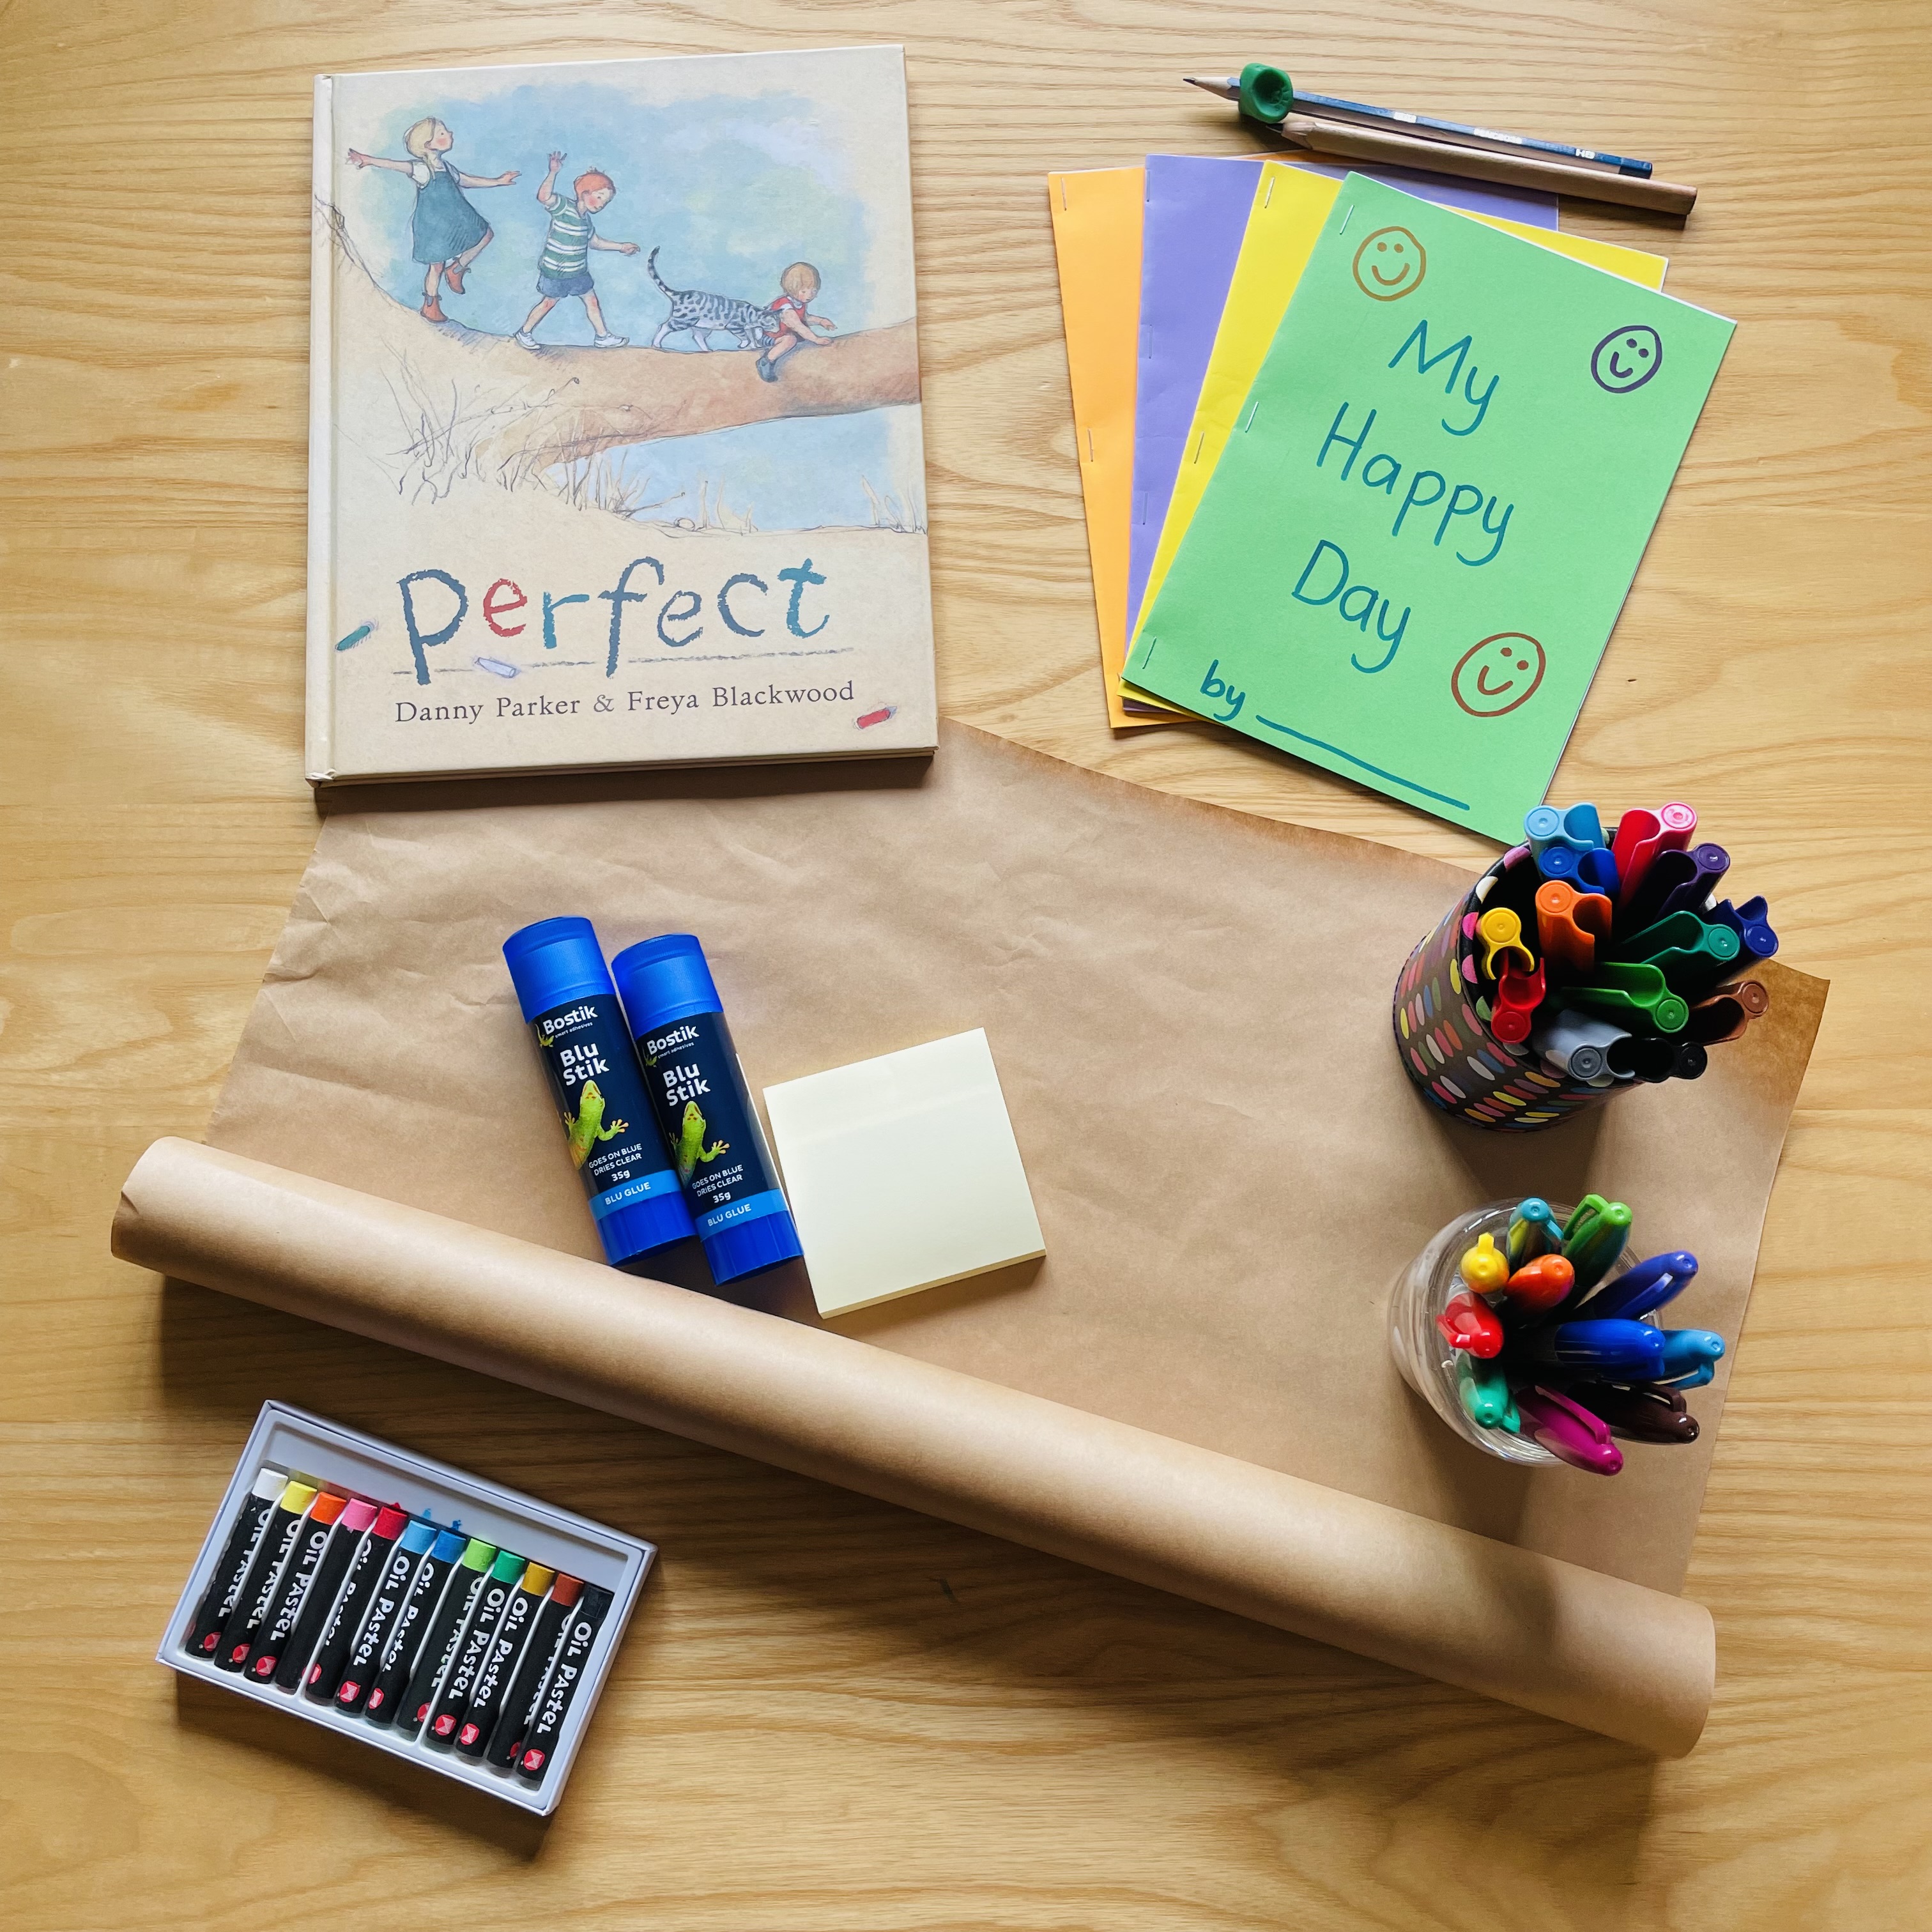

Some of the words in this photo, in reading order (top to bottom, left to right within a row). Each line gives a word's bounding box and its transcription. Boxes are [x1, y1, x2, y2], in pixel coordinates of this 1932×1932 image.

[1388, 319, 1499, 436] My
[1317, 402, 1514, 566] Happy
[1292, 540, 1411, 673] Day
[395, 702, 484, 724] Danny
[496, 695, 580, 717] Parker
[594, 694, 615, 712] &
[627, 691, 699, 715] Freya
[712, 680, 855, 707] Blackwood
[1200, 659, 1245, 721] by
[542, 1006, 599, 1035] Bostik
[647, 1025, 700, 1055] Bostik
[560, 1043, 599, 1068] Blu
[563, 1057, 610, 1086] Stik
[663, 1063, 700, 1088] Blu
[666, 1078, 711, 1107] Stik
[588, 1155, 608, 1169] GOES
[608, 1150, 621, 1160] ON
[620, 1143, 643, 1155] BLUE
[594, 1162, 615, 1176] DRIES
[615, 1153, 643, 1167] CLEAR
[611, 1169, 631, 1182] 35g
[692, 1177, 709, 1190] GOES
[709, 1172, 722, 1182] ON
[721, 1164, 744, 1177] BLUE
[696, 1183, 717, 1197] DRIES
[716, 1174, 743, 1188] CLEAR
[604, 1192, 623, 1206] BLU
[624, 1181, 651, 1197] GLUE
[712, 1192, 732, 1204] 35g
[707, 1213, 724, 1227] BLU
[724, 1203, 752, 1219] GLUE
